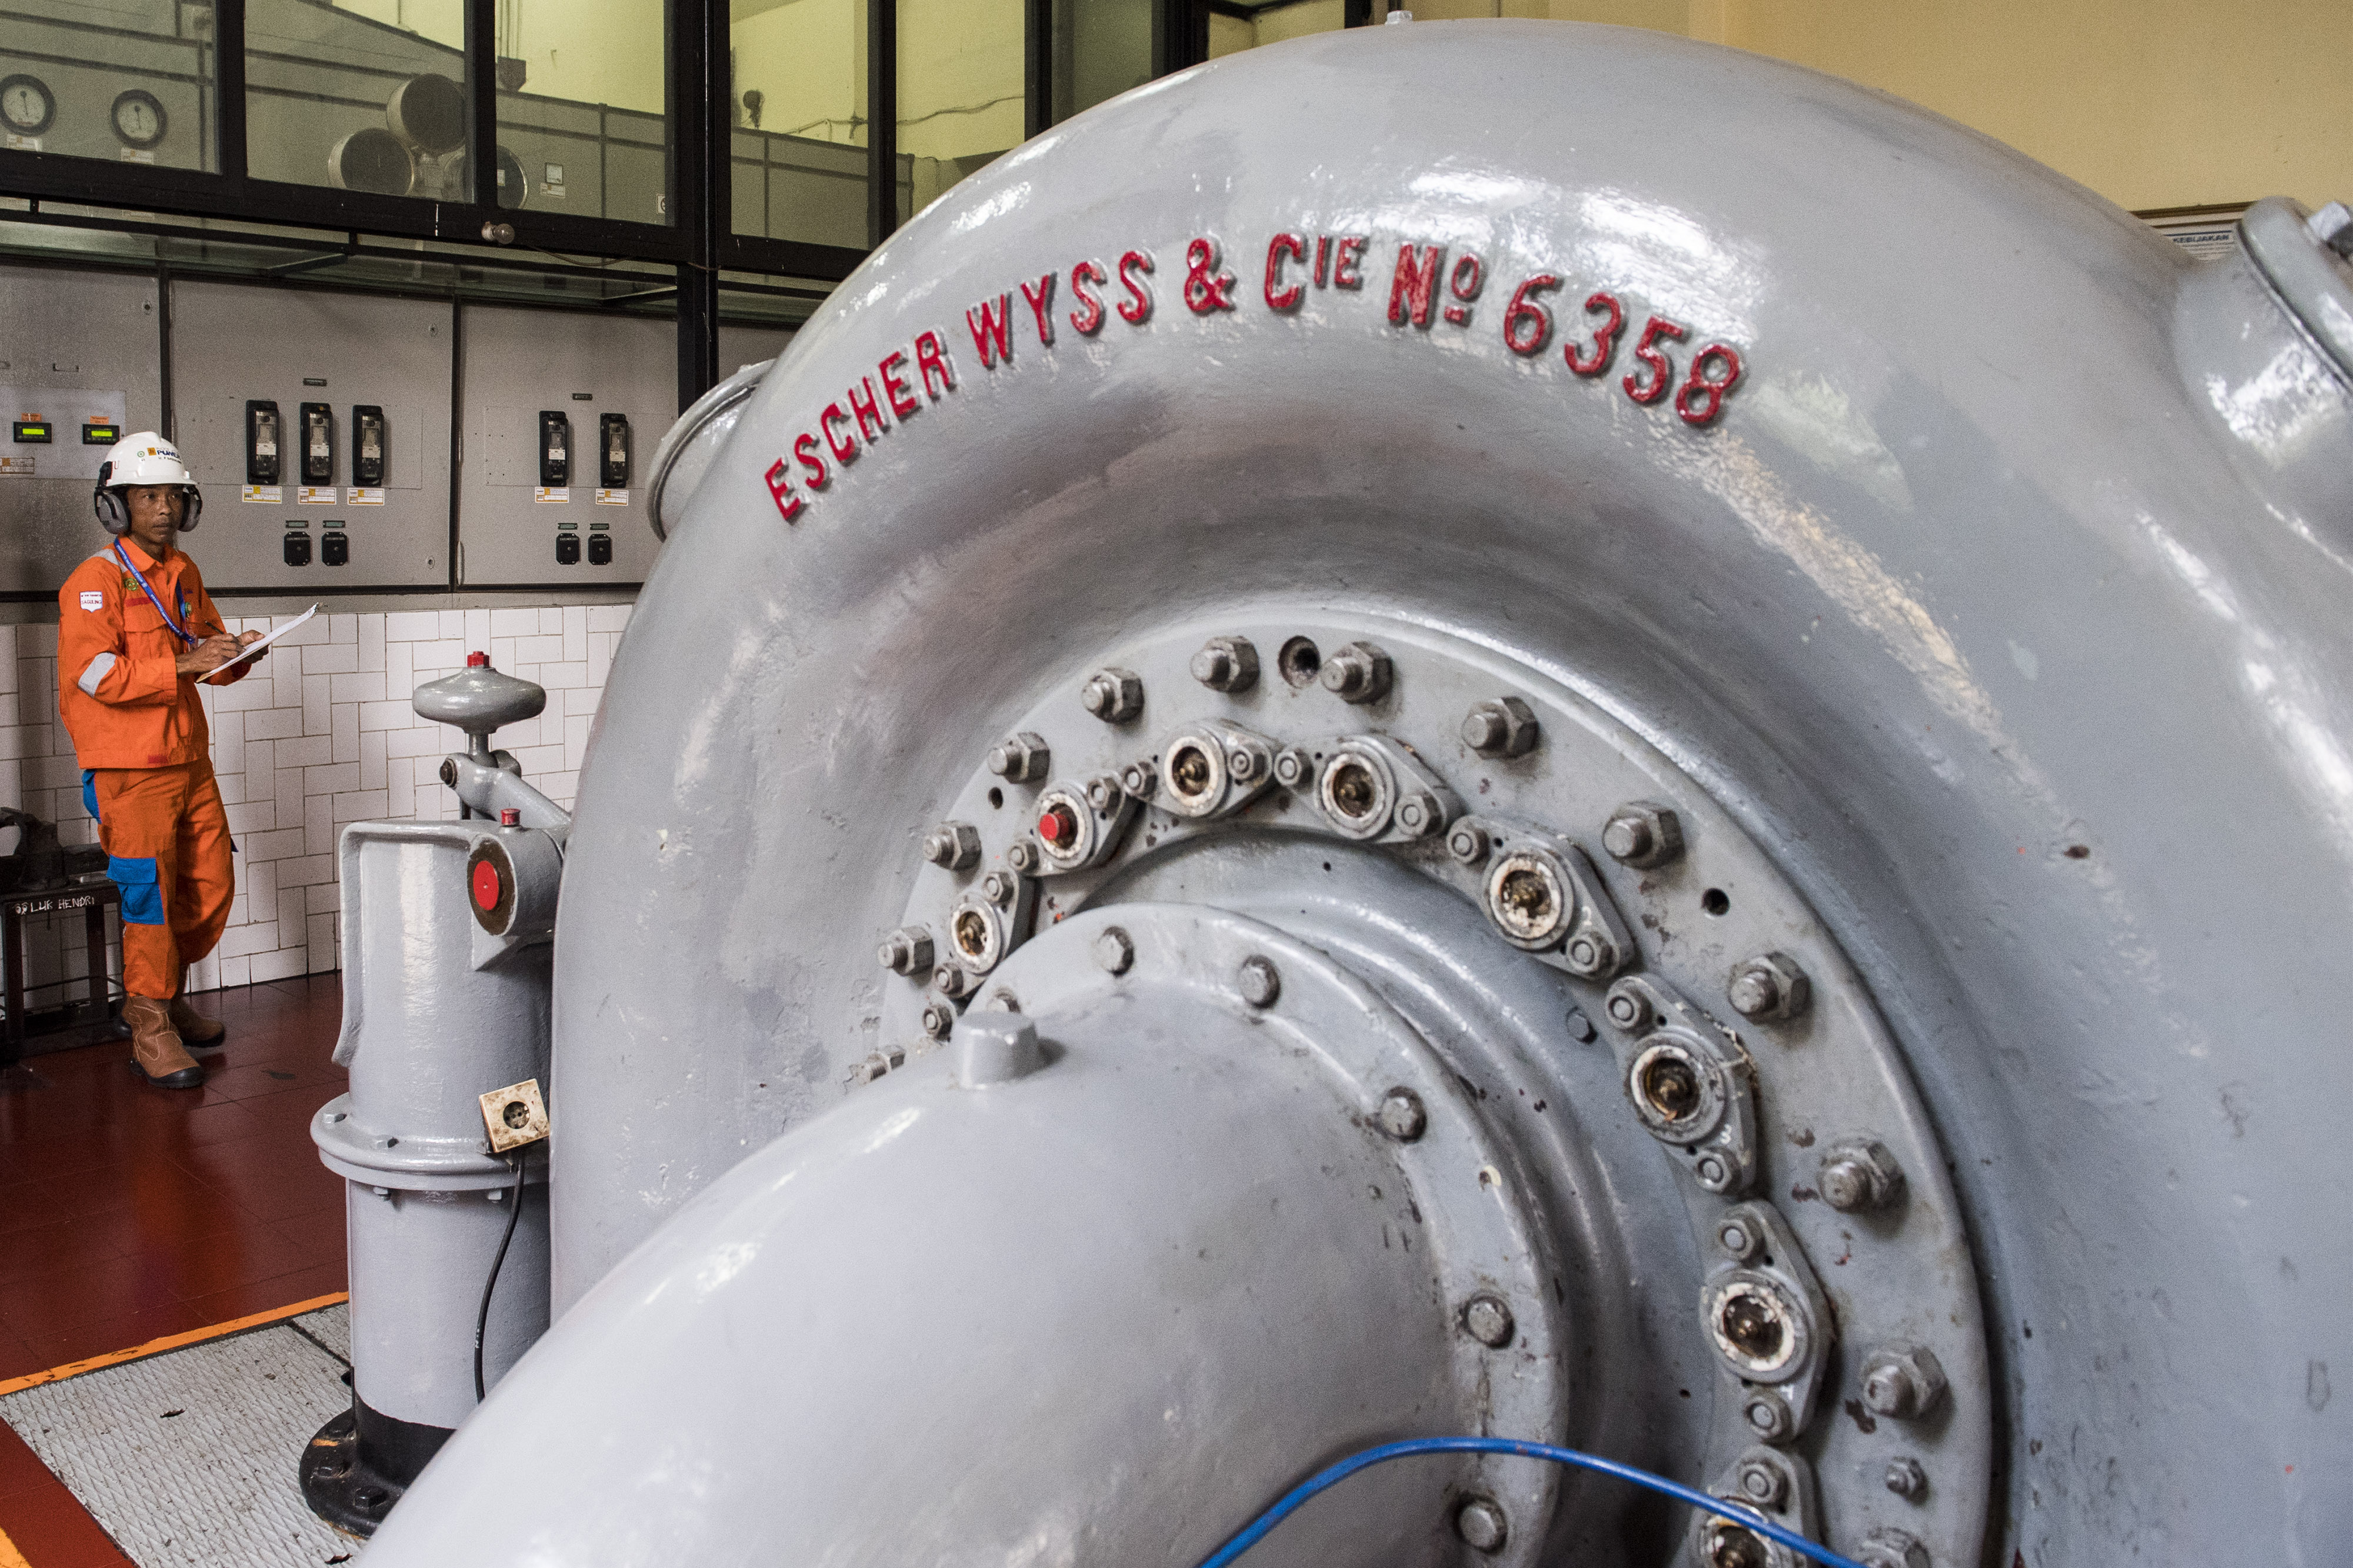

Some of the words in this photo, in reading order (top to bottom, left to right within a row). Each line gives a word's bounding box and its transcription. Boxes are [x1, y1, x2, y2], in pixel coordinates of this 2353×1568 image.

[764, 330, 954, 521] ESCHER
[966, 251, 1151, 368] WYSS
[1184, 238, 1231, 313] &
[1504, 275, 1741, 423] 6358
[1720, 1123, 1732, 1145] 3
